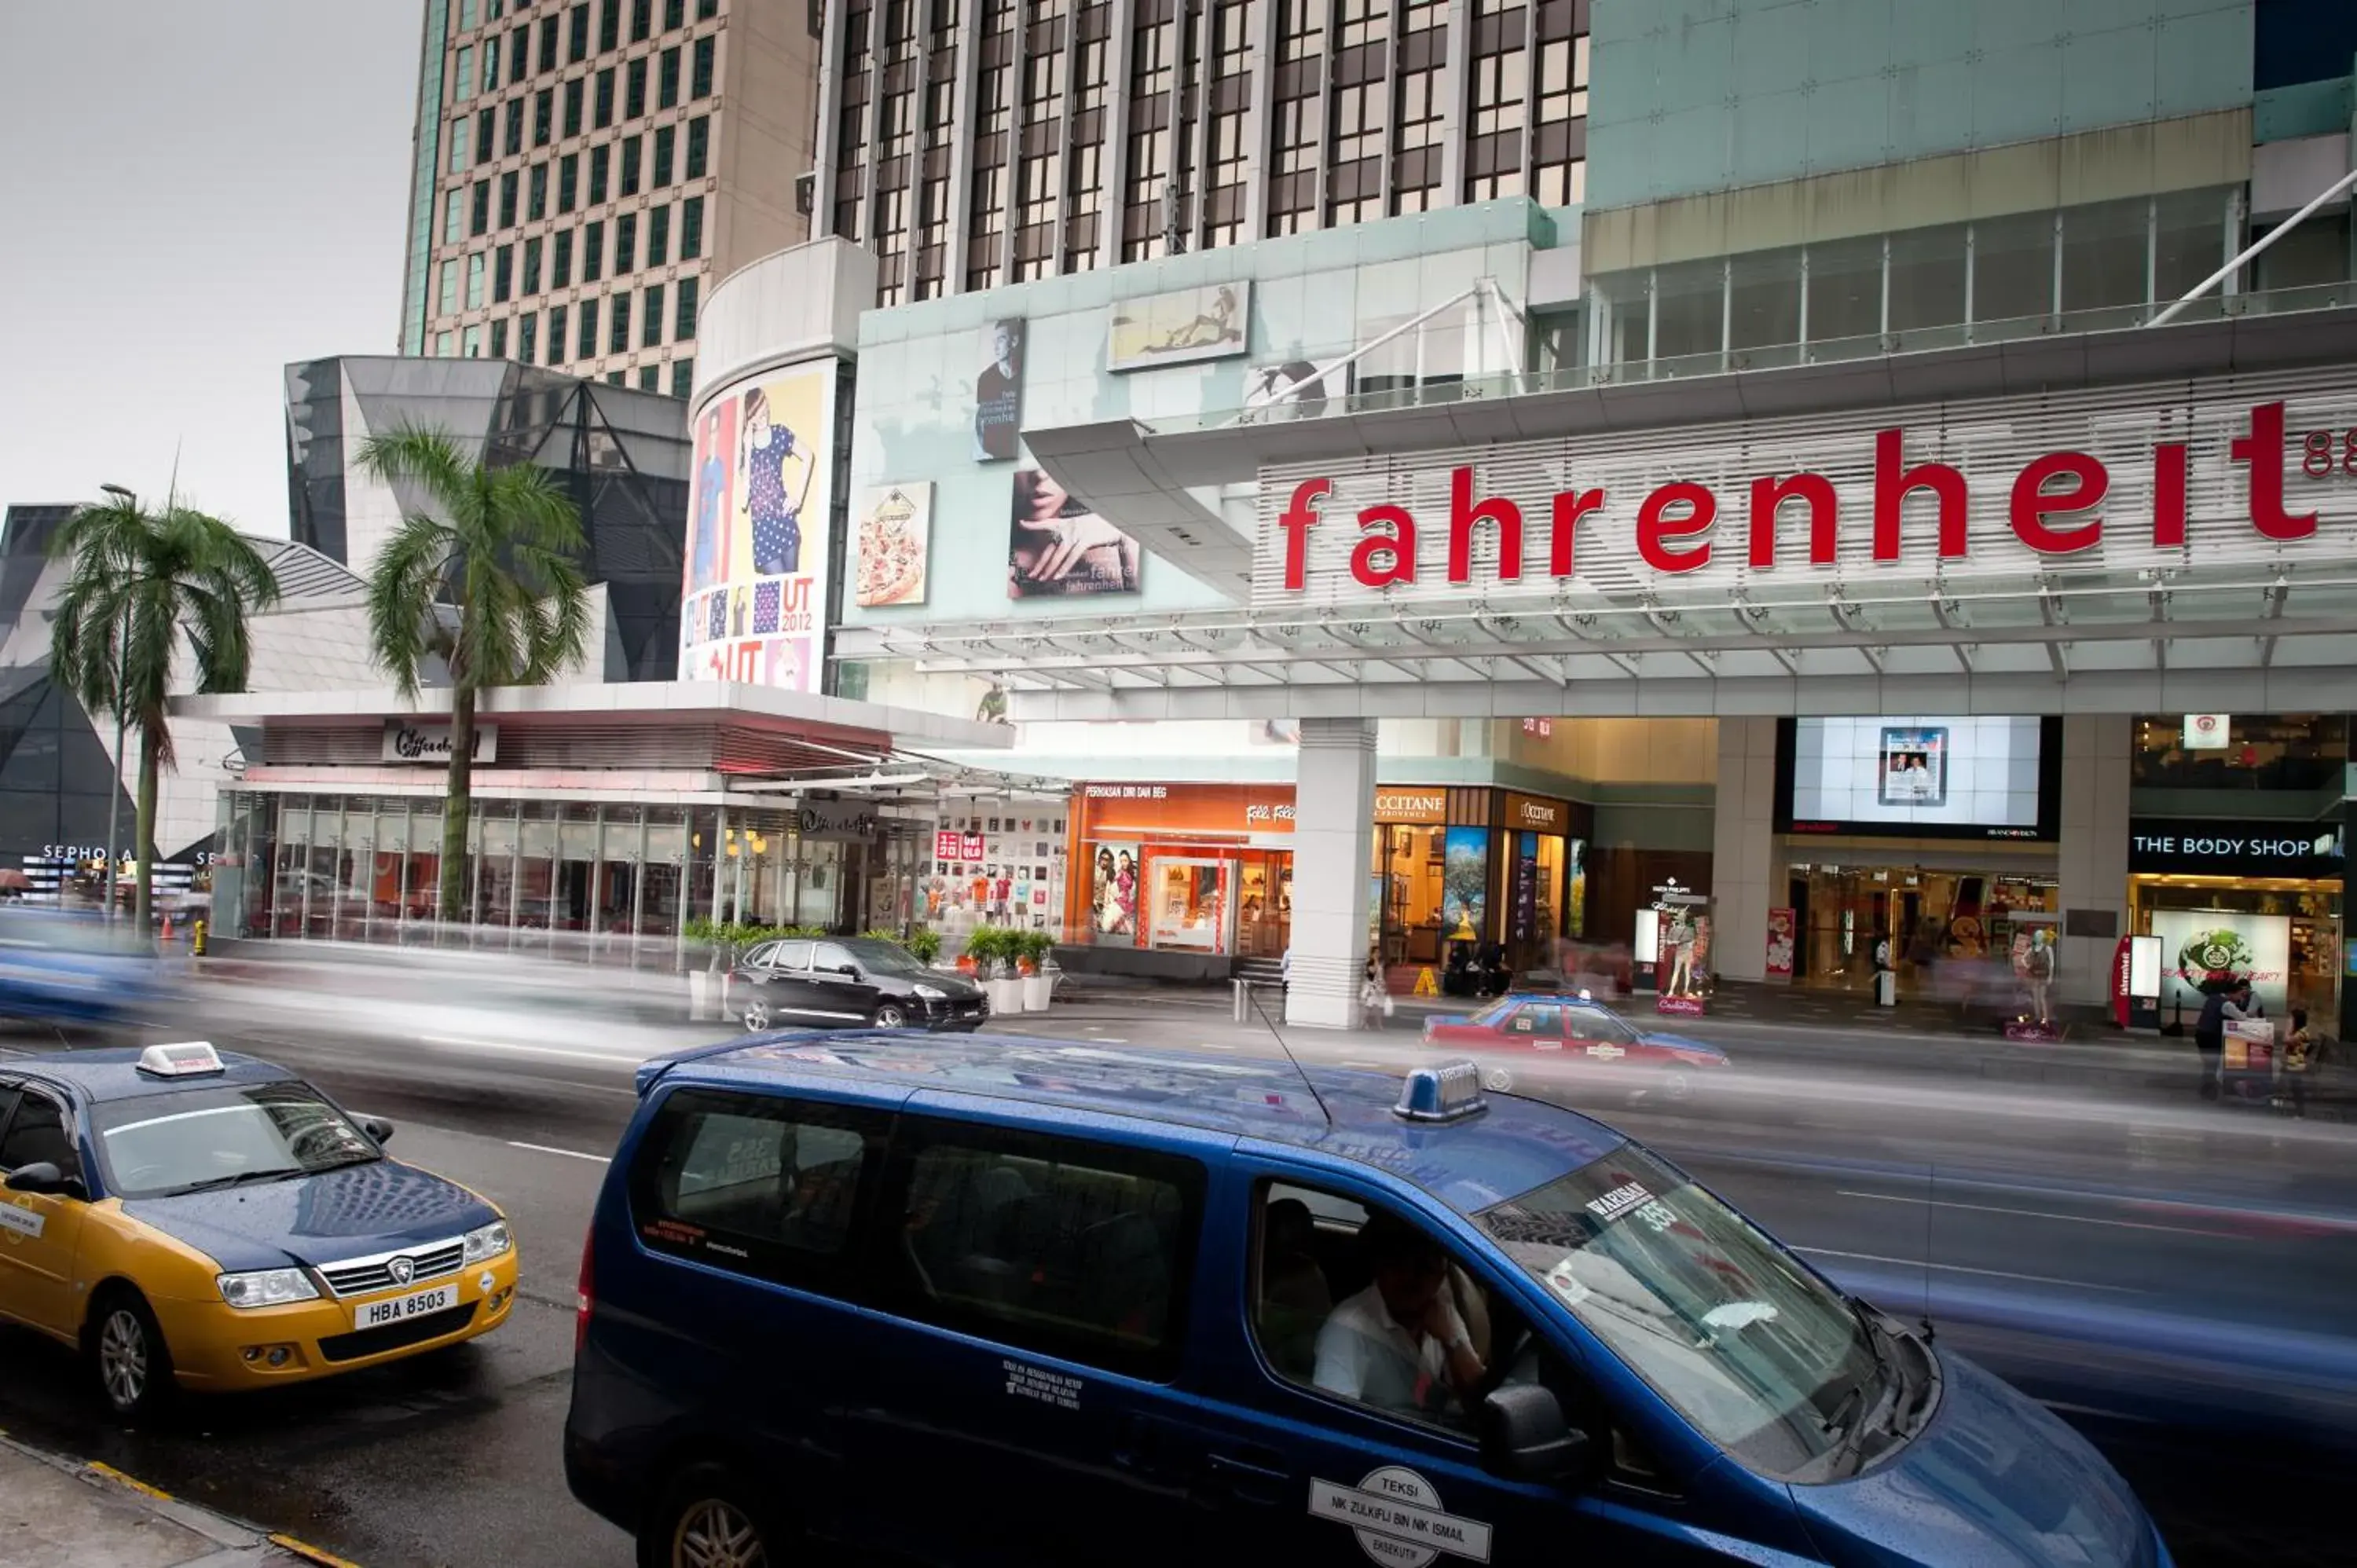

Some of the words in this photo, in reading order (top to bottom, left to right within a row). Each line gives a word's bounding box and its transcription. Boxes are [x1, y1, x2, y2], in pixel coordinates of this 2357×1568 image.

[1277, 399, 2318, 593] fahrenheit
[783, 577, 814, 613] UT
[782, 613, 812, 632] 2012
[43, 844, 133, 861] SEPHOA
[2132, 837, 2176, 853] THE
[2183, 837, 2245, 855] BODY
[2249, 839, 2311, 856] SHOP
[370, 1302, 402, 1324] HBA
[406, 1291, 445, 1315] 8503
[1381, 1477, 1419, 1497] TEKSI
[1393, 1511, 1410, 1526] BIN
[1432, 1522, 1465, 1543] ISMAIL
